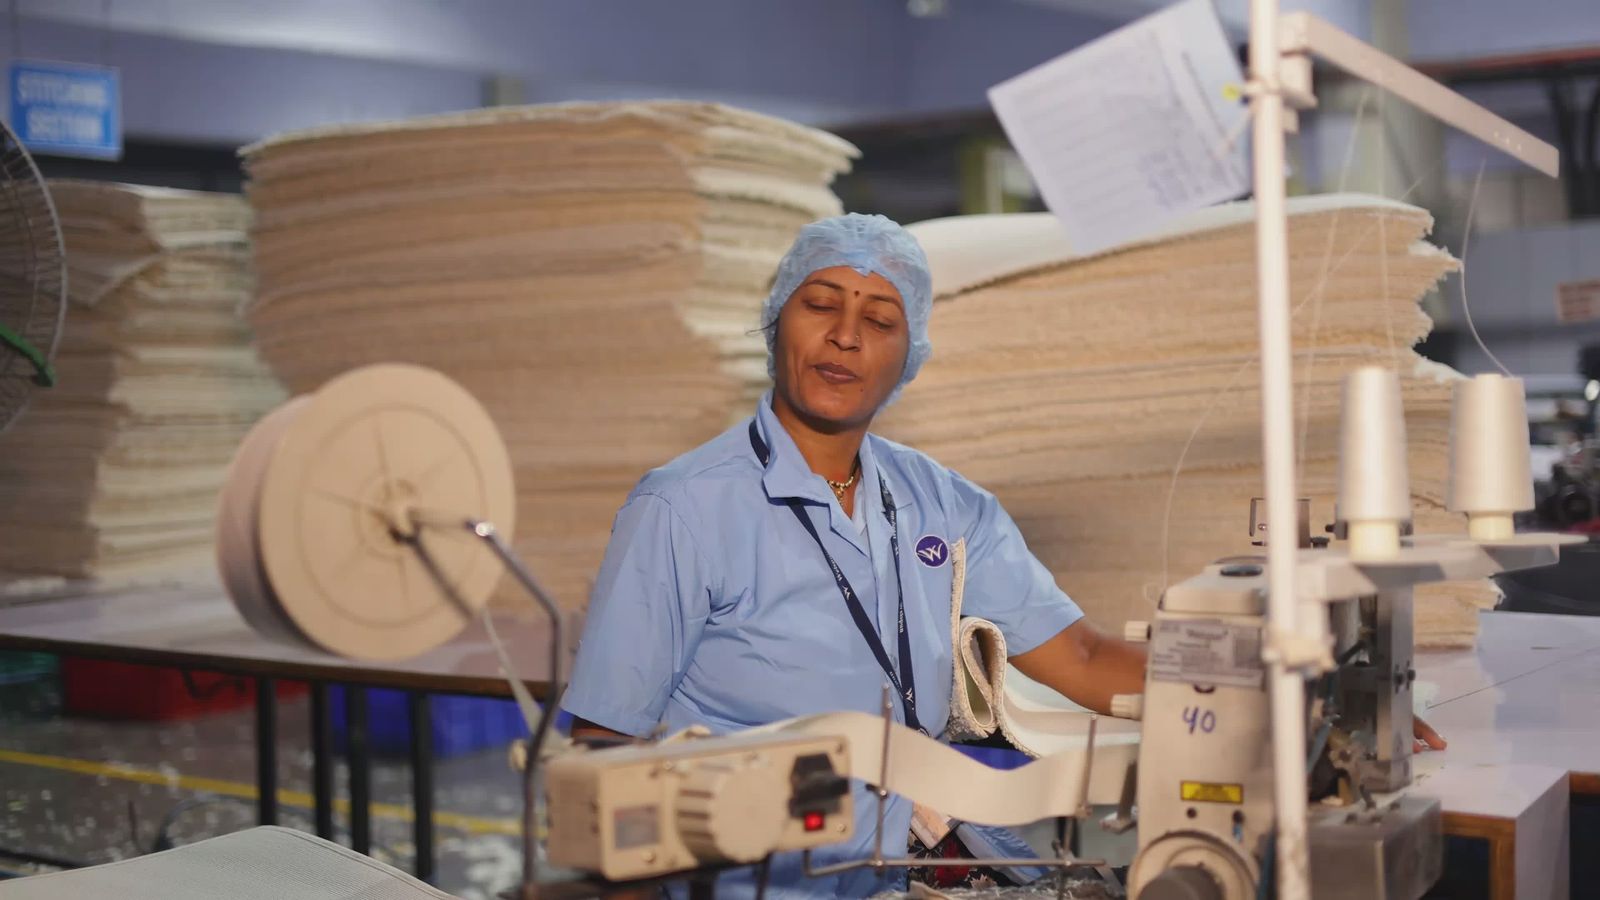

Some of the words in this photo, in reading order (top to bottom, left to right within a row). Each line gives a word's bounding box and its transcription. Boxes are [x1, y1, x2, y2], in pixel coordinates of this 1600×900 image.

[18, 71, 108, 106] STITC
[27, 108, 102, 141] SECTI
[1183, 706, 1216, 735] 40
